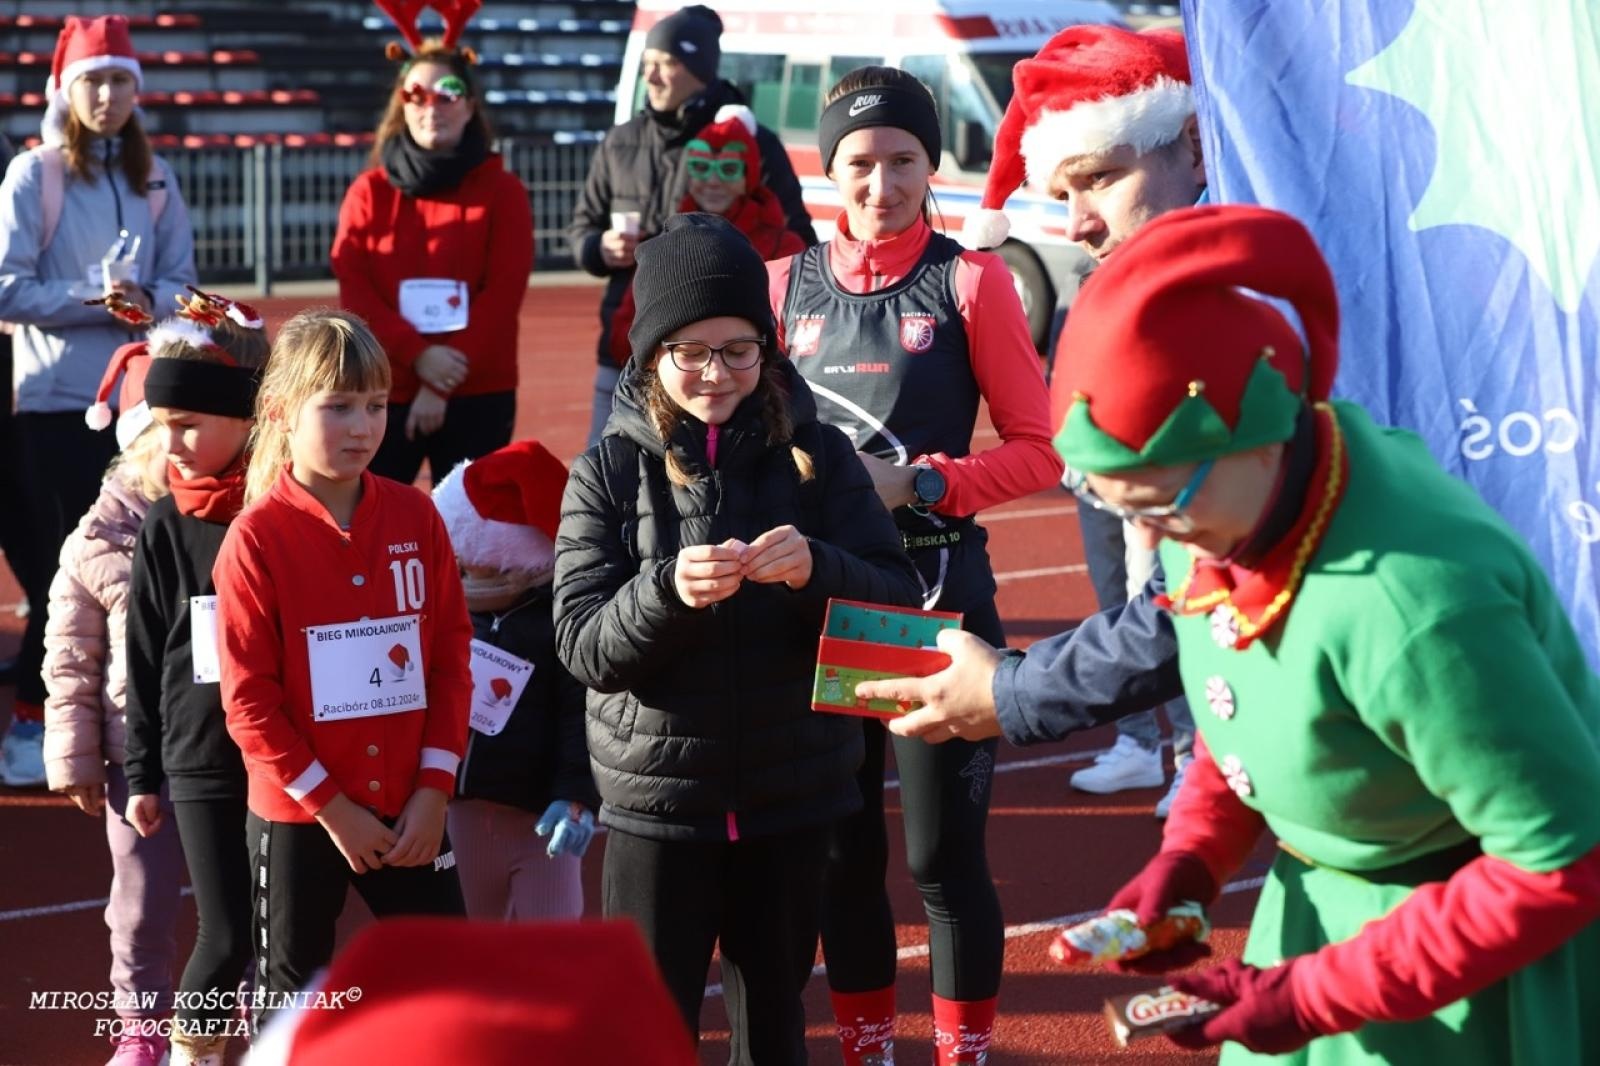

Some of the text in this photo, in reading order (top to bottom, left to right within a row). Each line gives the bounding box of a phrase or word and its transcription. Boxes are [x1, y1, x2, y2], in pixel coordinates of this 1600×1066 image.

[854, 95, 882, 107] RUN
[949, 531, 961, 543] 10
[387, 541, 419, 555] POLSKA
[389, 558, 426, 612] 10
[316, 622, 412, 642] BIEG MIKOŁAJKOWY
[369, 667, 383, 688] 4
[323, 698, 368, 714] Racibórz
[434, 851, 456, 872] PUM
